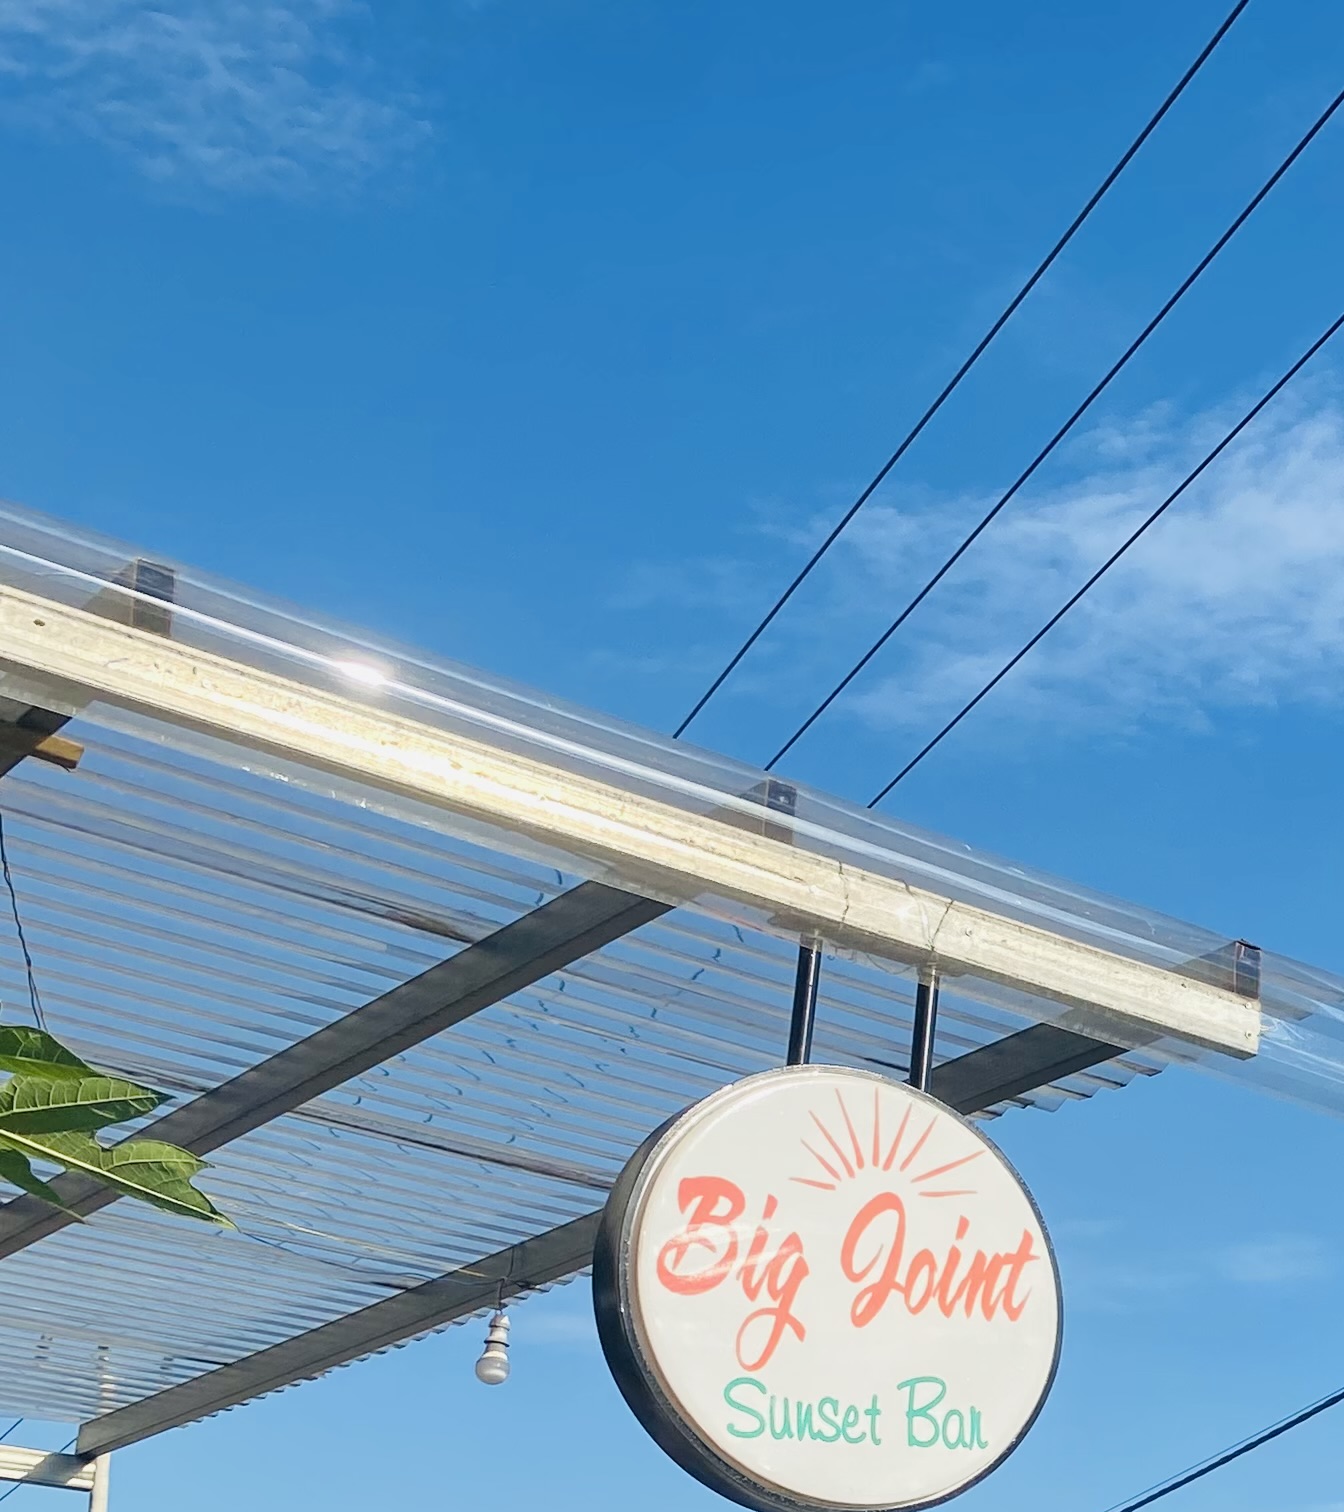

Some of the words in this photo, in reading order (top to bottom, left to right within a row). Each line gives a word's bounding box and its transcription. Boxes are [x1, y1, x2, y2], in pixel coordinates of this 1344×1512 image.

[656, 1176, 810, 1371] Big
[840, 1192, 1041, 1328] Joint
[723, 1377, 881, 1445] Sunset
[897, 1376, 988, 1451] Bar
